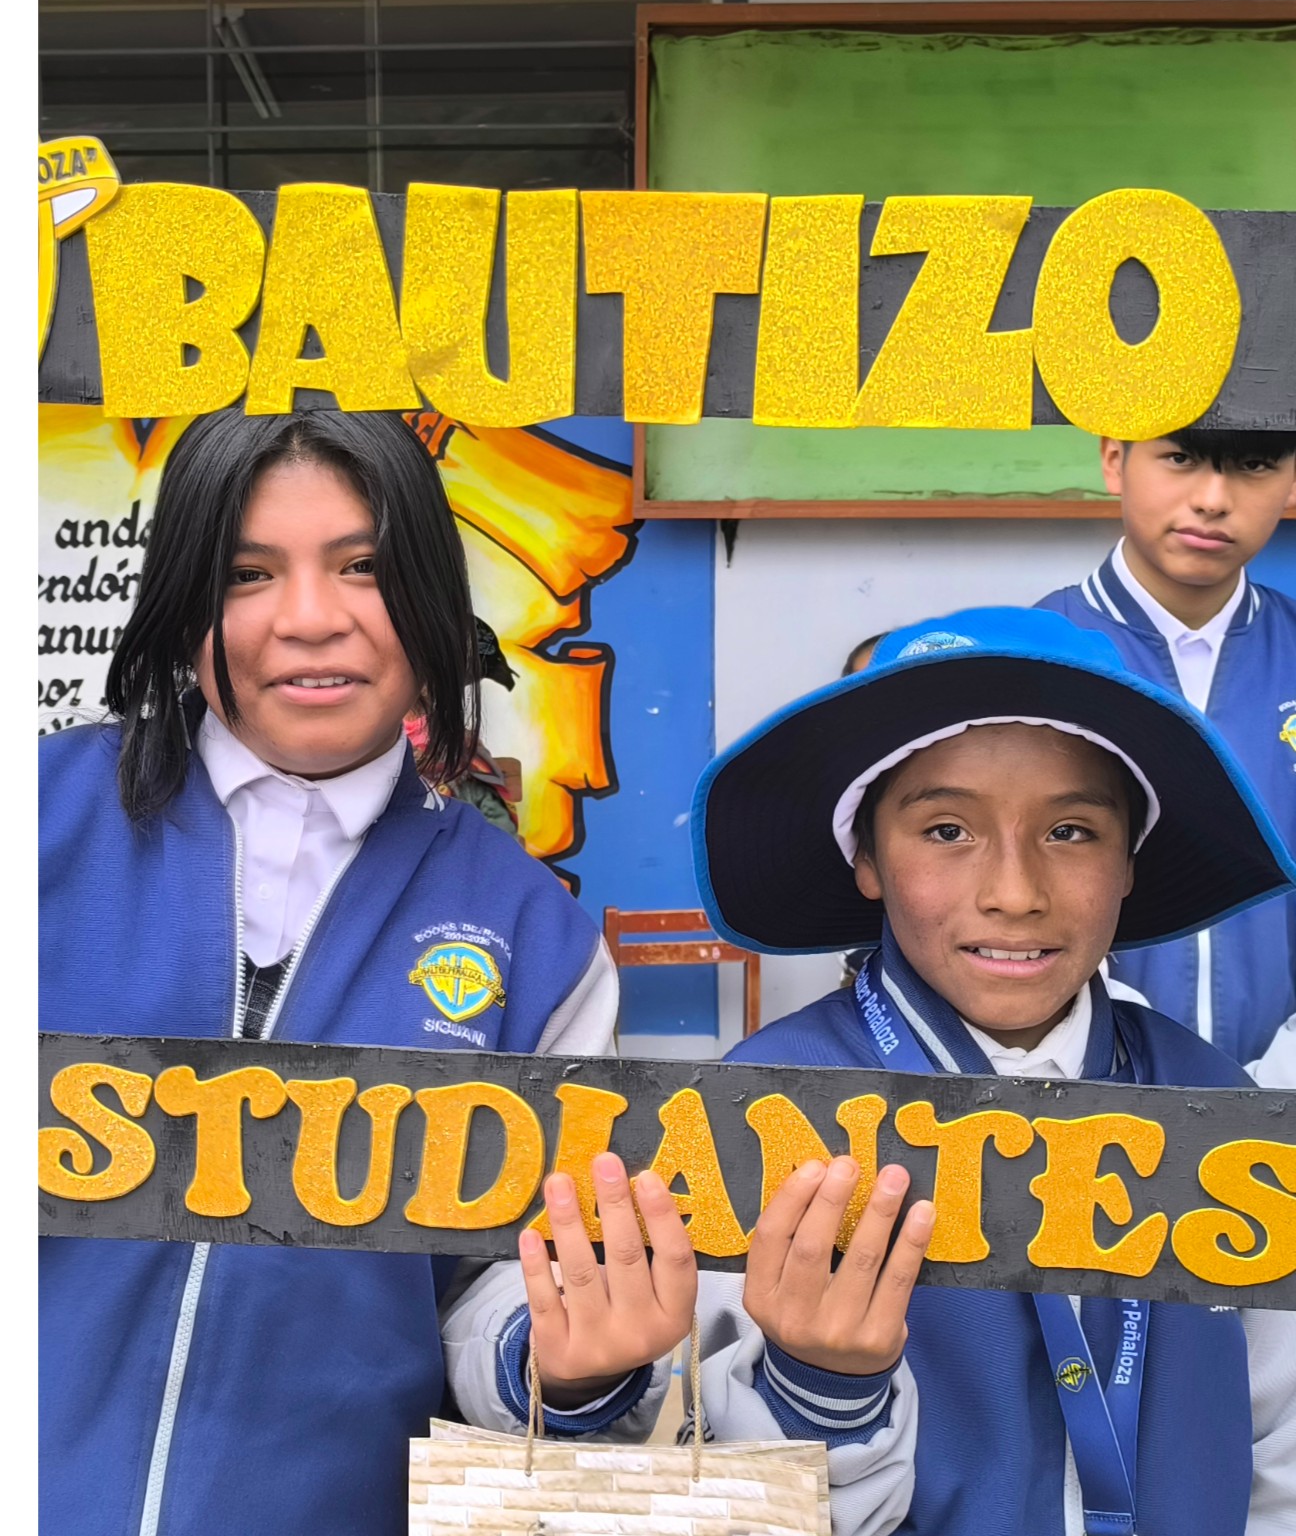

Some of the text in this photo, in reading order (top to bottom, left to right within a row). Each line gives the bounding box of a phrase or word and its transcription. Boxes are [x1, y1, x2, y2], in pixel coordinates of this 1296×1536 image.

[84, 181, 1242, 441] BAUTIZO
[423, 1018, 486, 1047] SICUANI
[861, 992, 900, 1056] Peñaloza
[1114, 1308, 1142, 1385] Peñaloza
